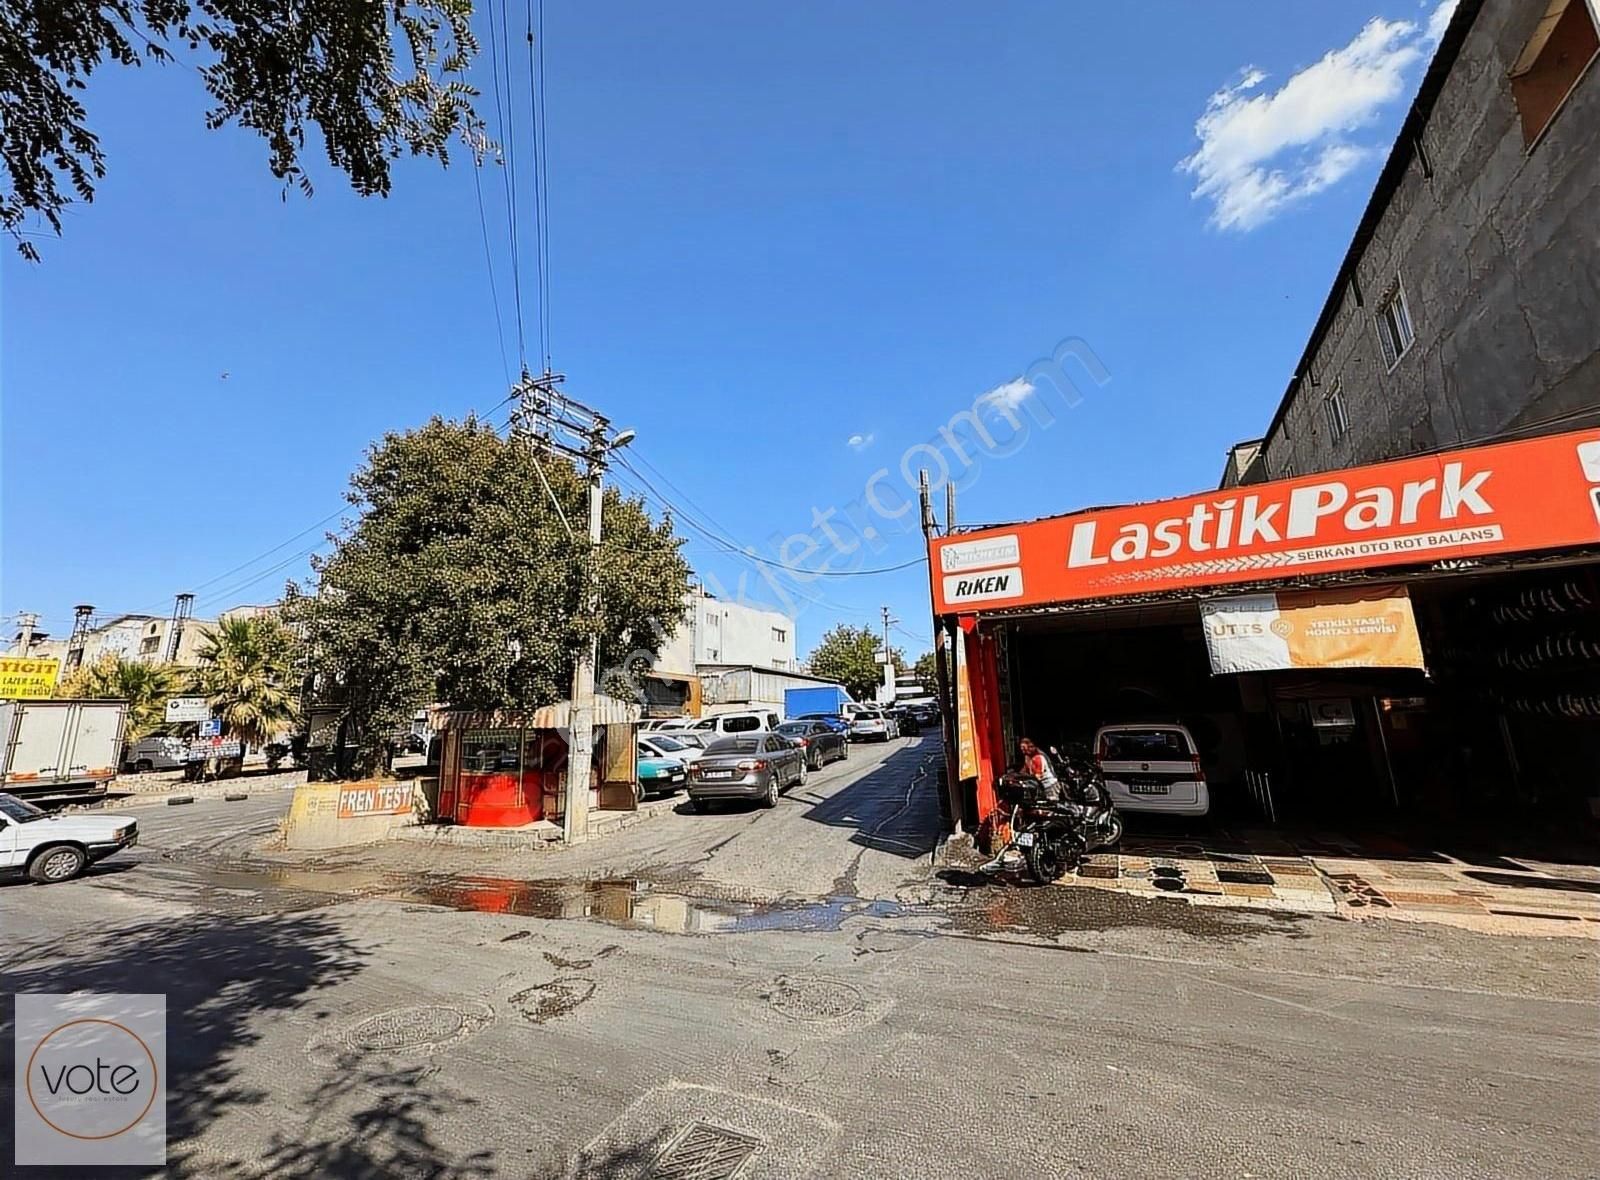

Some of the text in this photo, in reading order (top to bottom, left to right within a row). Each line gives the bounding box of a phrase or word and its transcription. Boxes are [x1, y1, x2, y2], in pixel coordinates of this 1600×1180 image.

[1297, 528, 1495, 562] SERKAN OTO ROT BALANS
[1213, 622, 1265, 637] UTTS
[339, 788, 376, 812] FREN
